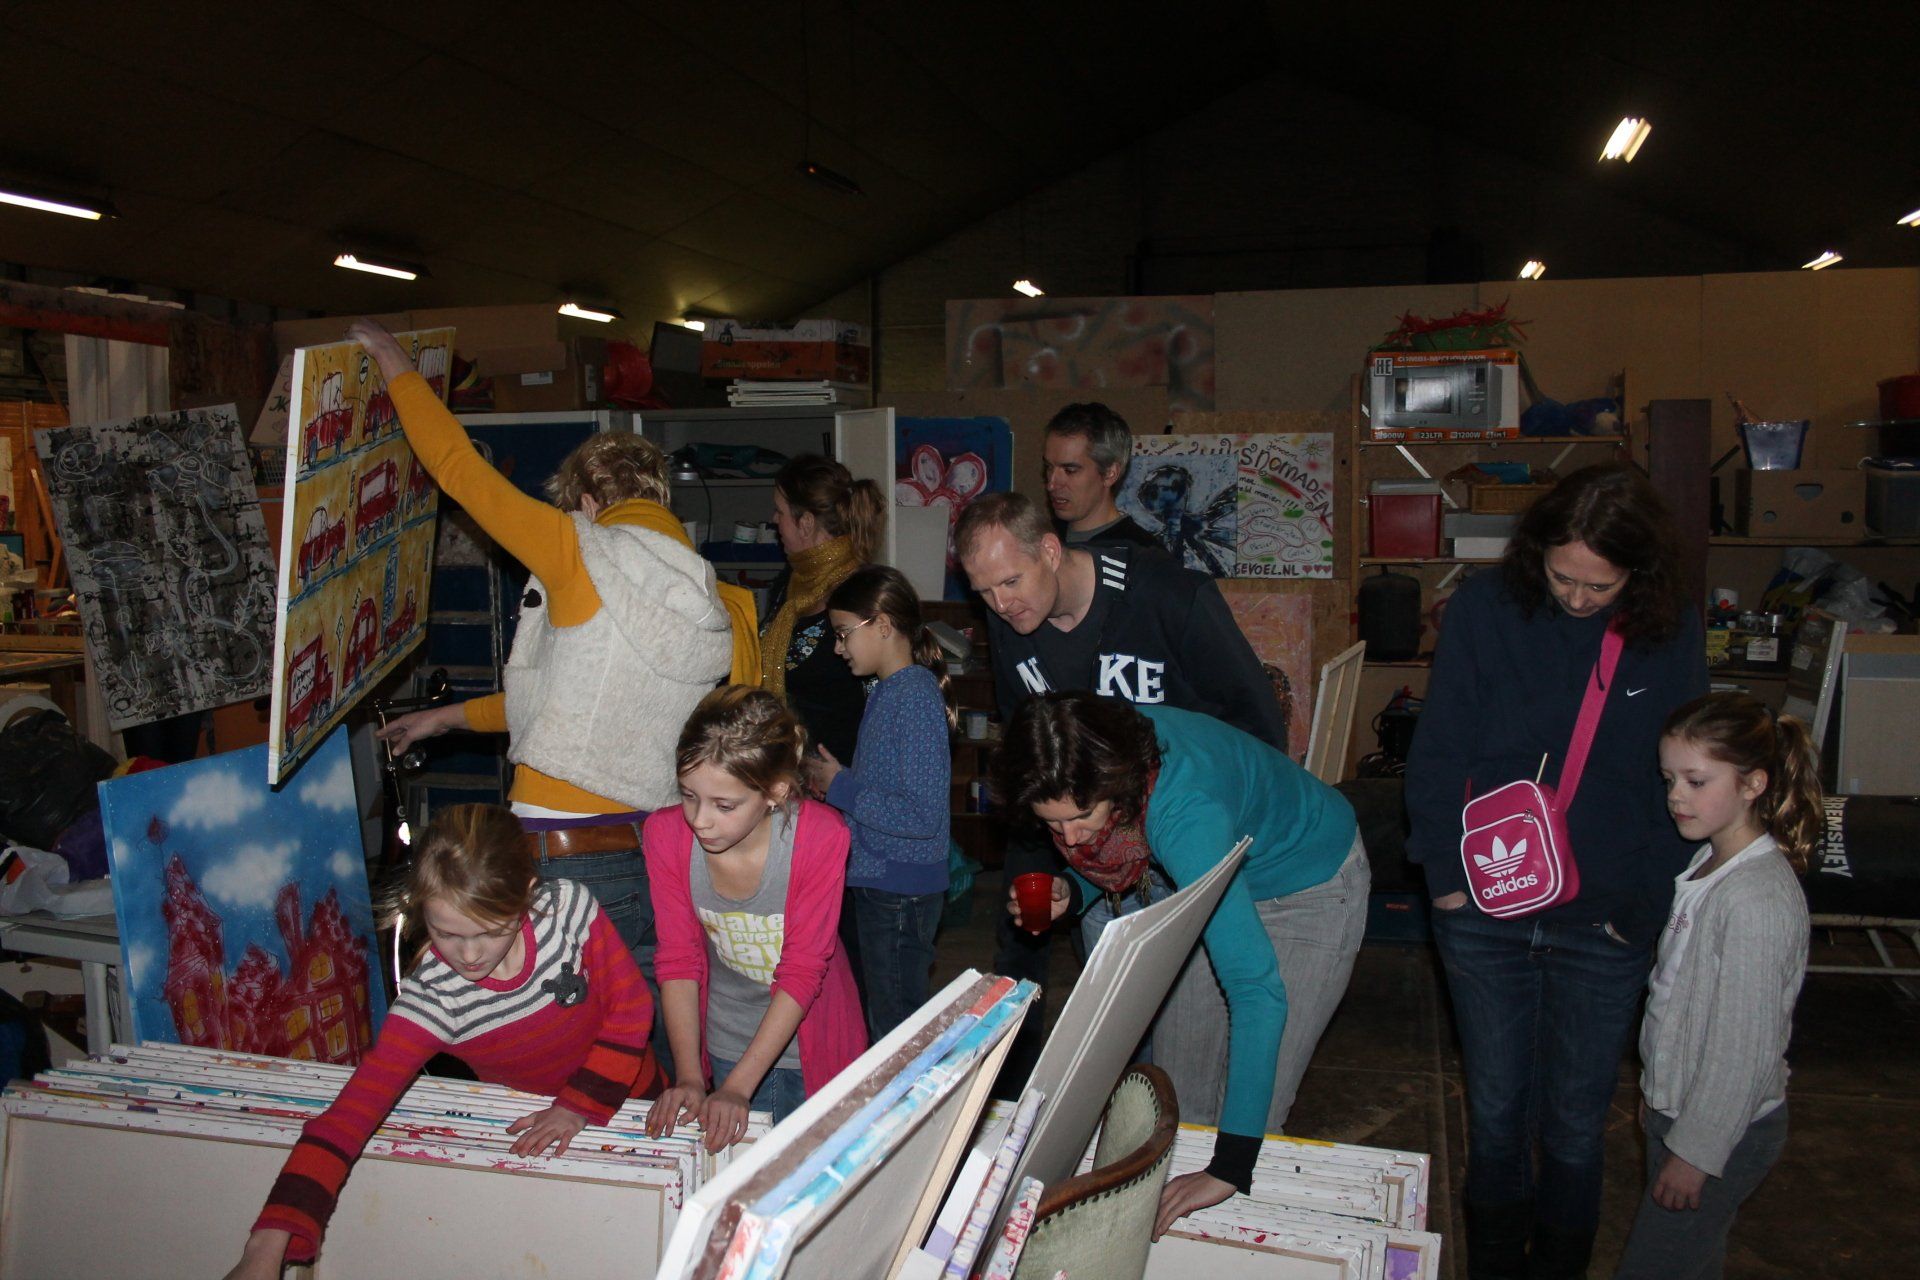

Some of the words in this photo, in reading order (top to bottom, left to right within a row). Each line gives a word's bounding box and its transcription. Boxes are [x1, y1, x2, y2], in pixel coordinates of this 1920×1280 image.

[1376, 359, 1392, 374] HE
[1820, 796, 1853, 879] BREMSHEY
[1482, 872, 1538, 900] adidas
[699, 907, 784, 932] make
[730, 931, 784, 944] ever
